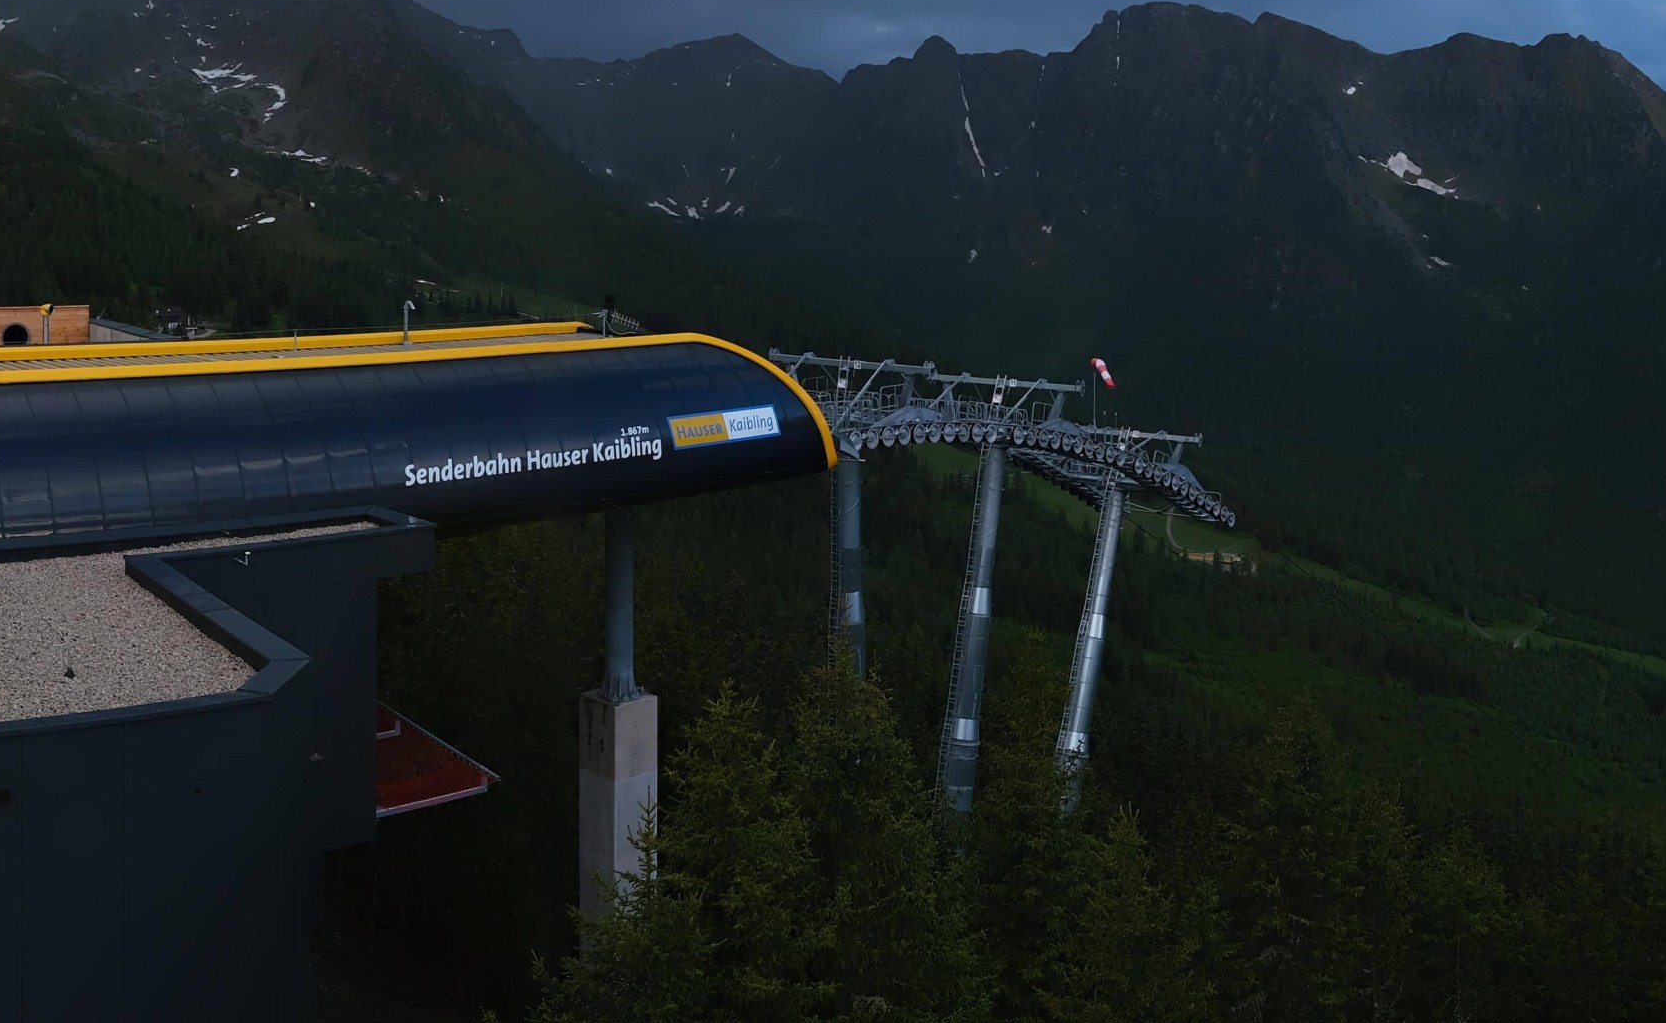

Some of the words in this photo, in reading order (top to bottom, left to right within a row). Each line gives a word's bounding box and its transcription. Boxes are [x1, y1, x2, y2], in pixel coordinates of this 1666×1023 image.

[620, 425, 650, 438] 1.867m
[676, 422, 724, 440] HAUSER
[729, 414, 774, 433] Kaibling
[404, 452, 522, 487] Senderbahn
[526, 444, 589, 472] Hauser
[592, 436, 662, 463] Kaibling
